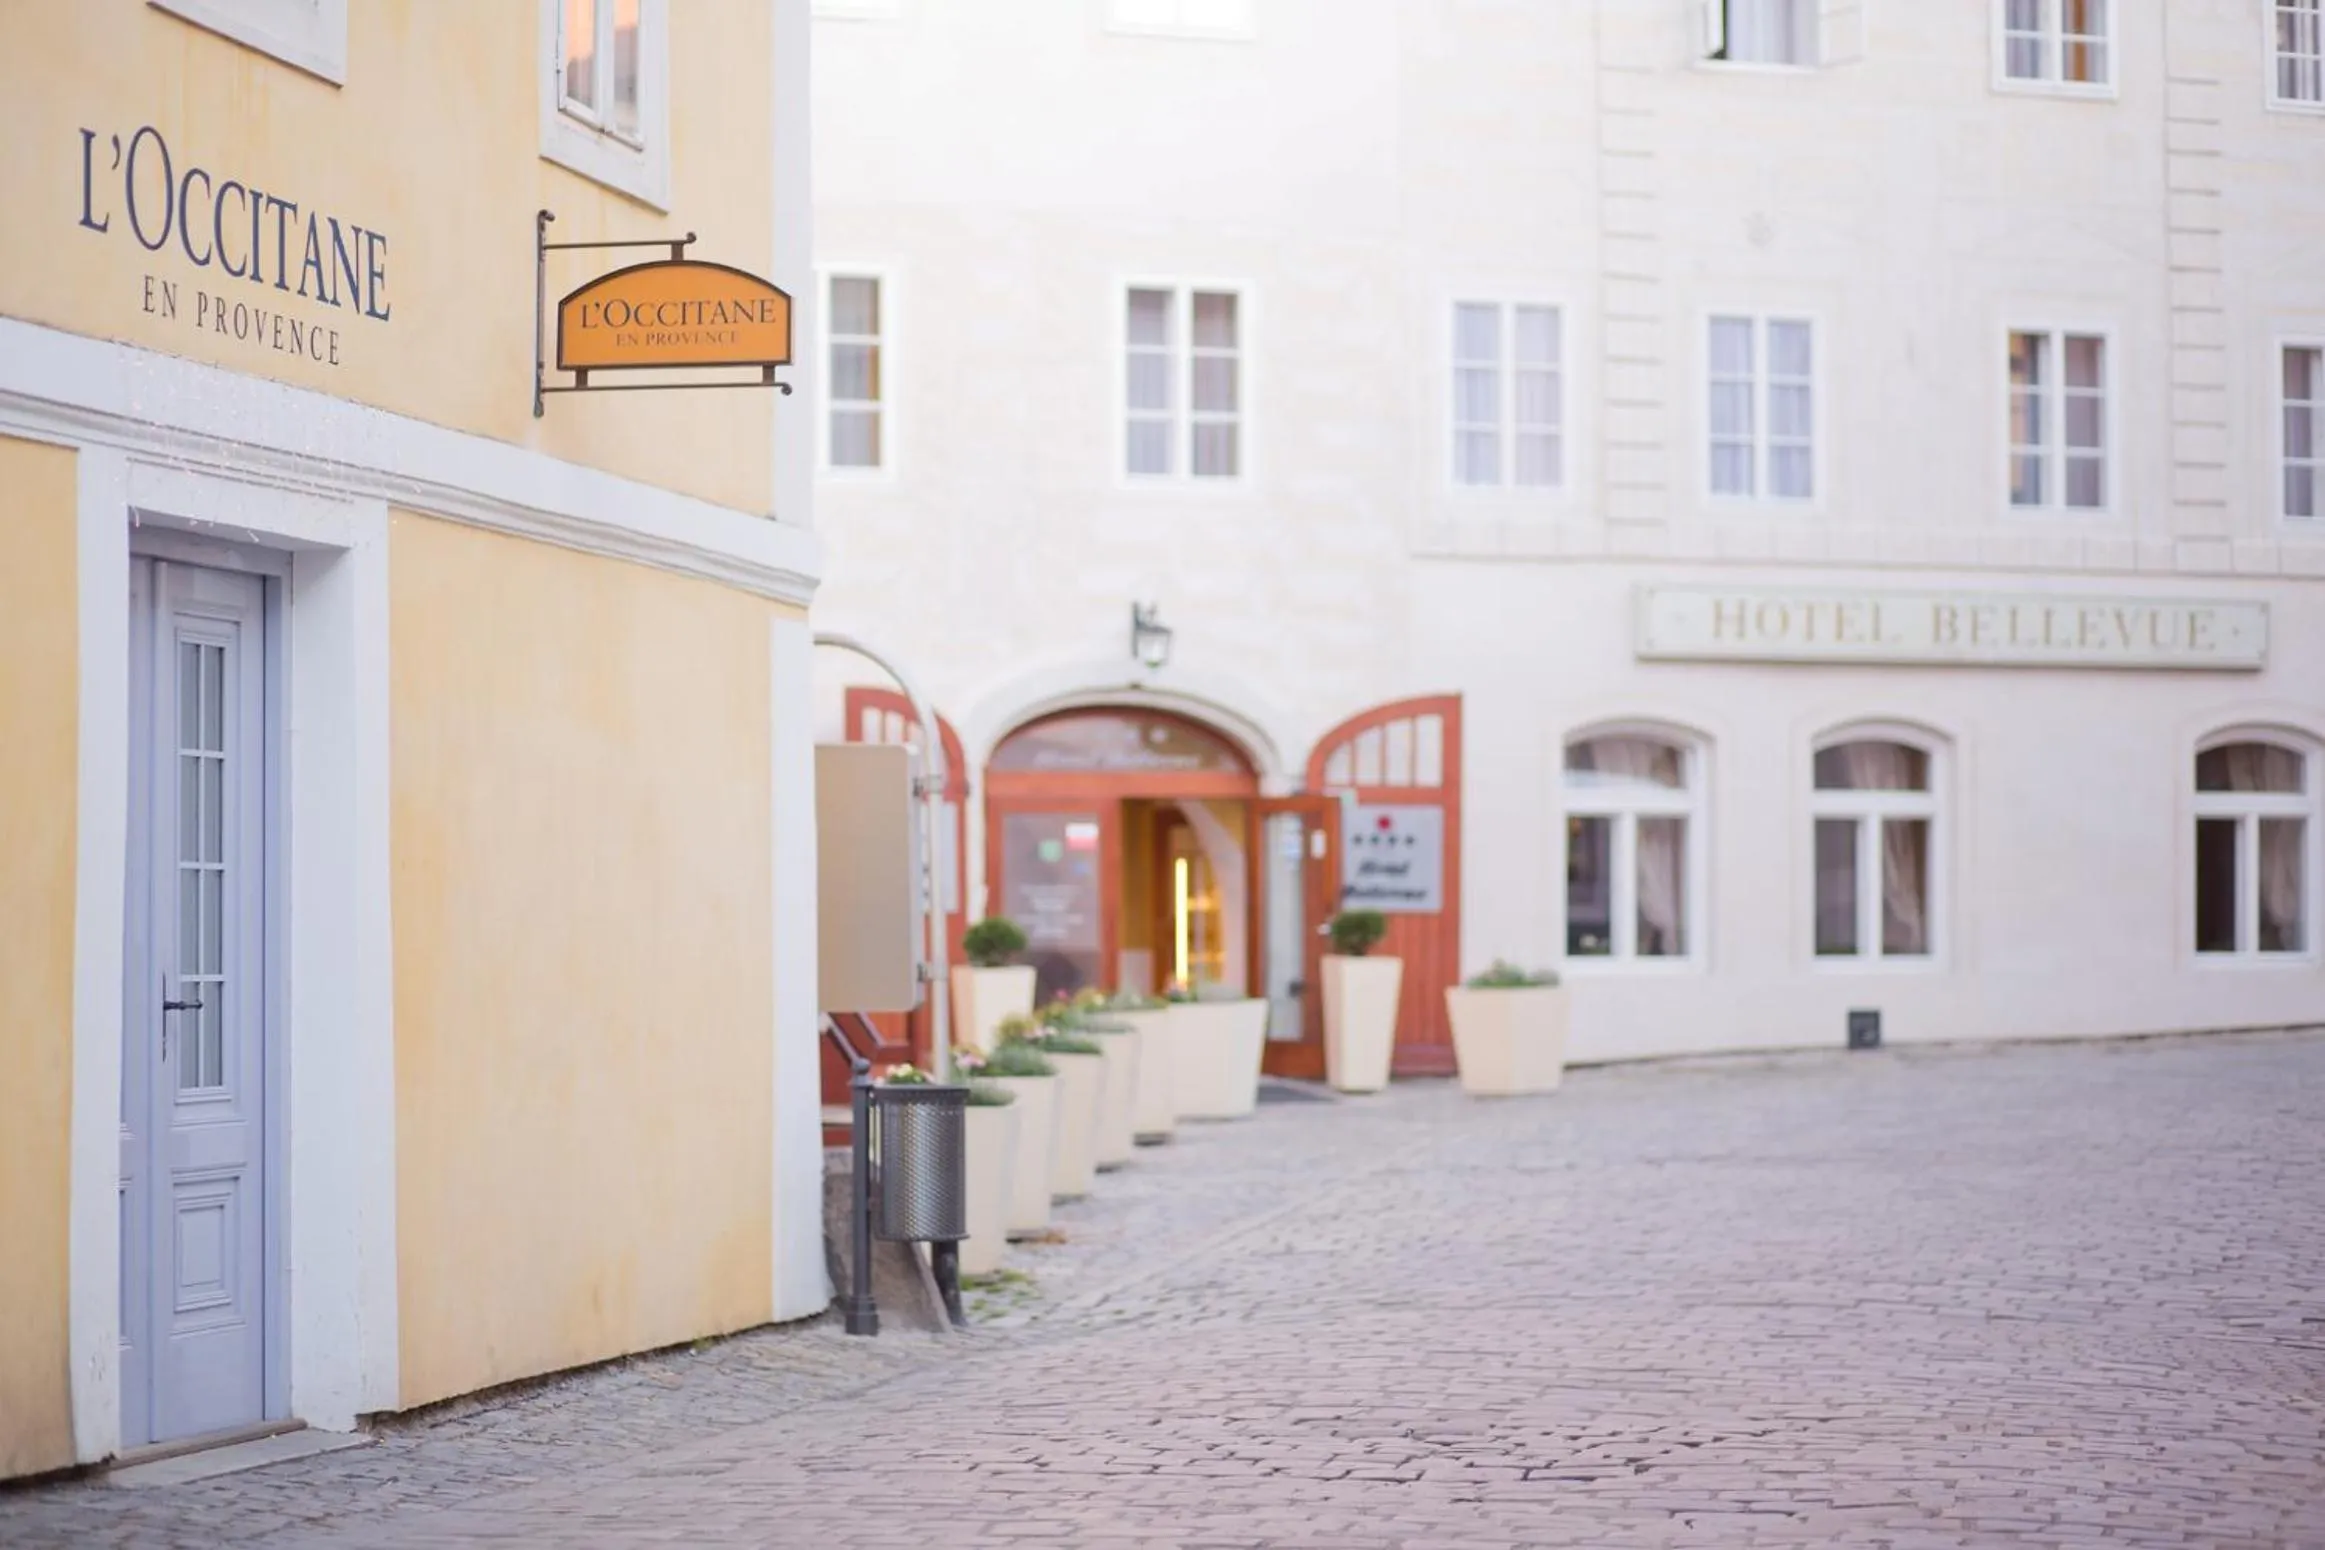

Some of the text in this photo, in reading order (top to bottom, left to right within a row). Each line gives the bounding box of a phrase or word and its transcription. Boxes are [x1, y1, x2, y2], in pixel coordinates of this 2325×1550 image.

[79, 126, 391, 322] L'OCCITANE
[143, 274, 340, 366] EN PROVENCE
[581, 299, 776, 328] L'OCCITANE
[616, 331, 738, 347] EN PROVENCE
[1711, 598, 2217, 653] HOTEL BELLEVUE
